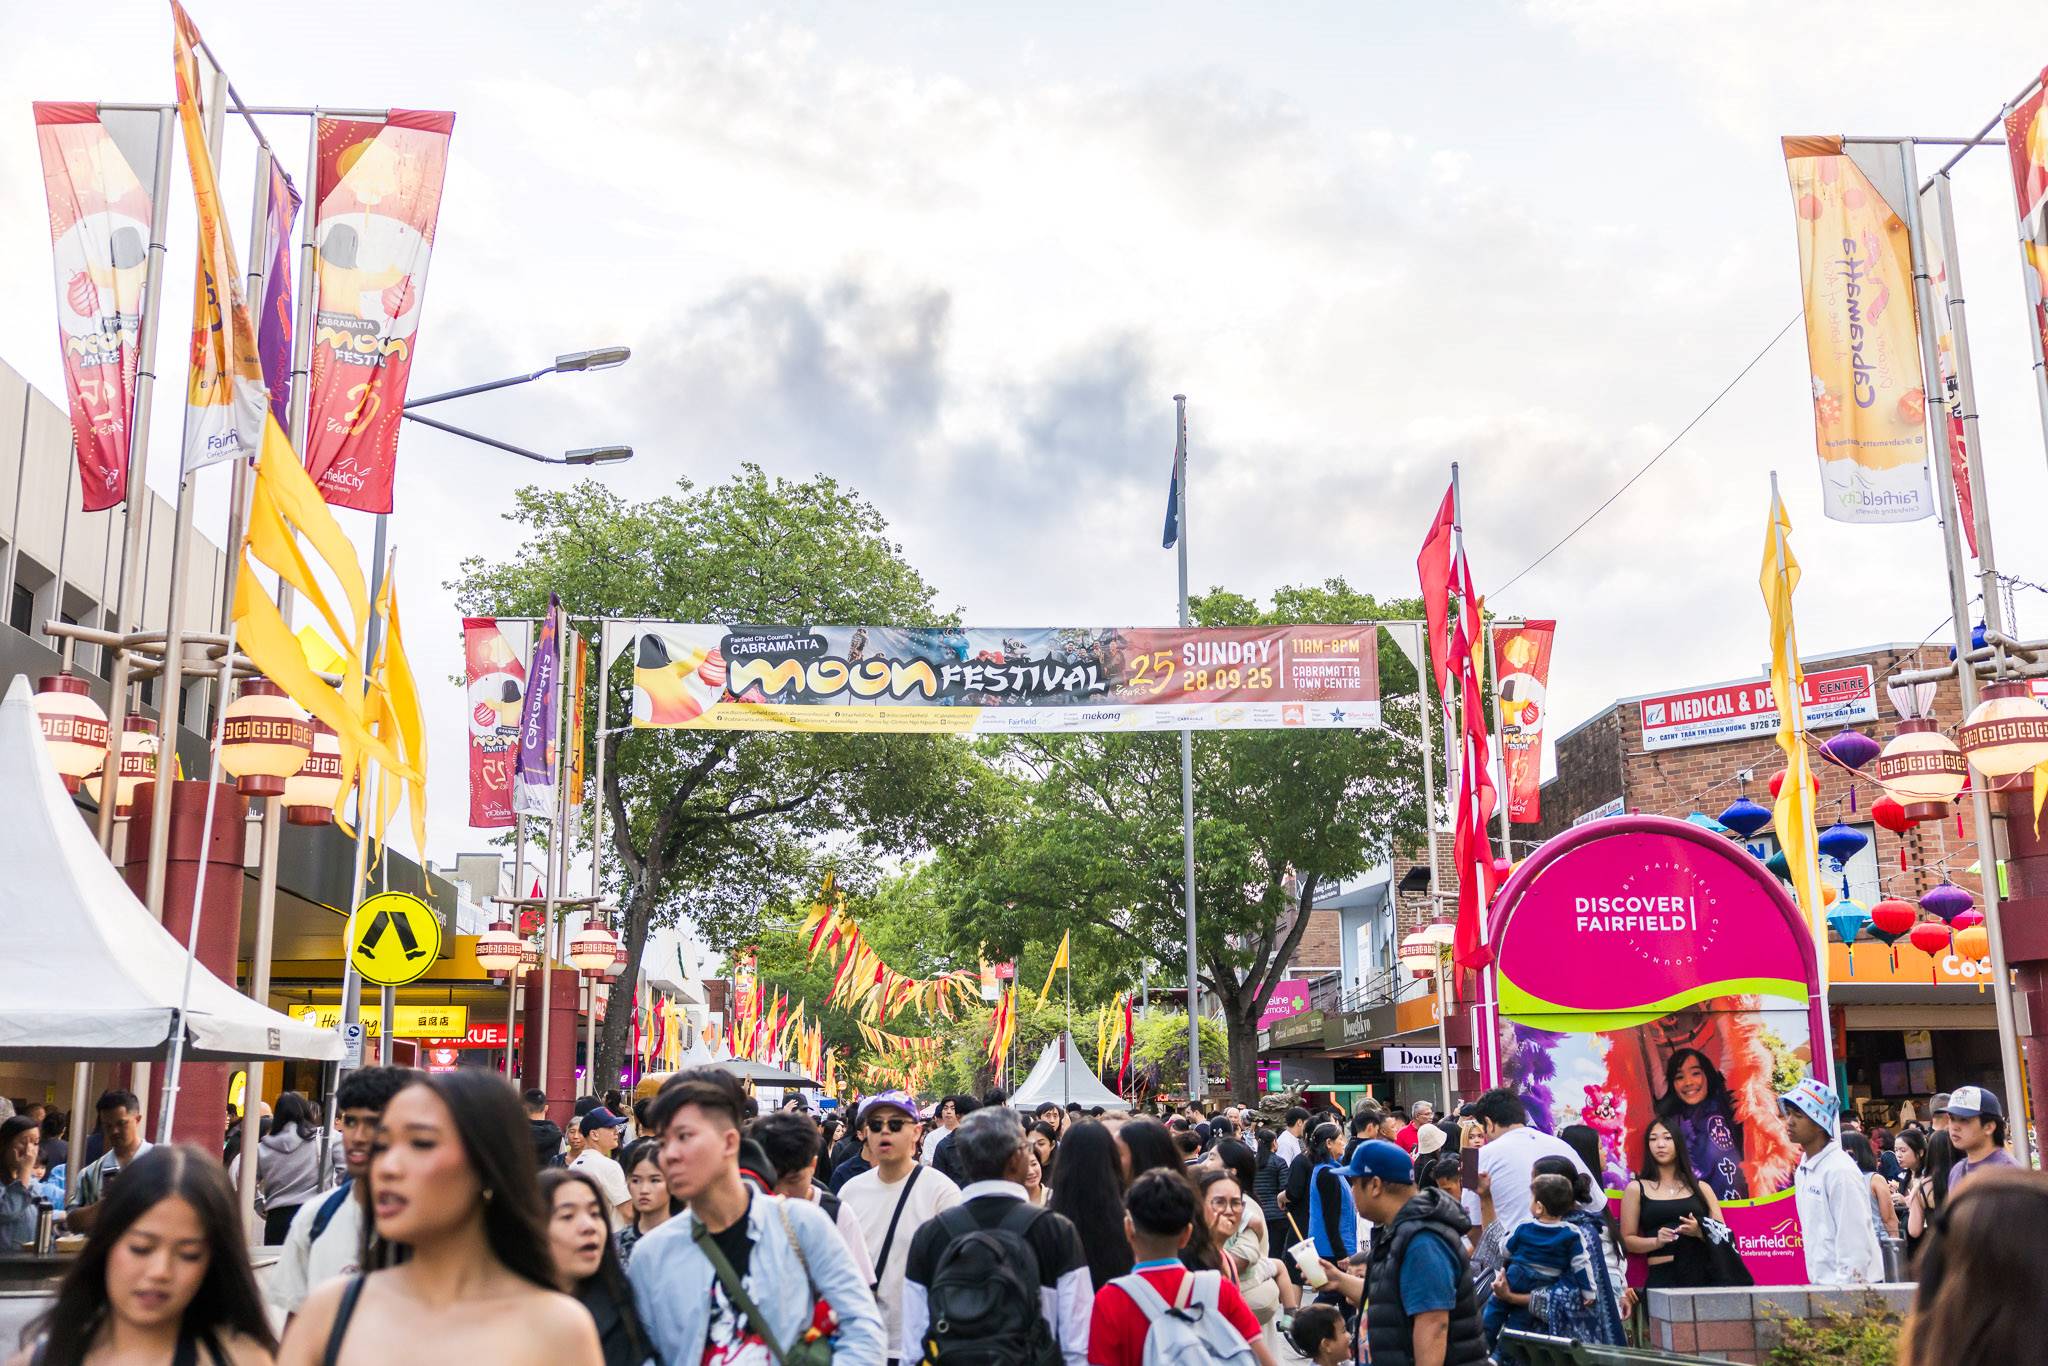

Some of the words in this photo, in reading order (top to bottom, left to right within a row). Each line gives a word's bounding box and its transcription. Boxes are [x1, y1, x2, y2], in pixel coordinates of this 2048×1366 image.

[730, 639, 819, 655] CABRAMATTA
[1183, 639, 1272, 667] SUNDAY
[1292, 638, 1360, 654] 11AM-8PM
[940, 664, 1106, 692] FESTIVAL
[1128, 650, 1176, 694] 25
[1183, 667, 1273, 692] 28.09.25
[1292, 665, 1361, 678] CABRAMATTA
[1293, 677, 1321, 689] TOWN
[1324, 677, 1361, 689] CENTRE
[525, 653, 552, 750] Cabramatta
[1670, 693, 1734, 722] MEDICAL
[1739, 691, 1751, 712] &
[1820, 678, 1864, 694] CENTRE
[1008, 717, 1037, 726] Fairfield
[1082, 711, 1121, 721] mekong
[1750, 721, 1769, 731] 9726
[1659, 733, 1678, 741] CATHY
[1622, 875, 1635, 890] BY
[1644, 862, 1717, 905] FAIRFIELD
[1575, 896, 1685, 913] DISCOVER
[1576, 915, 1687, 932] FAIRFIELD
[1702, 918, 1719, 952] CITY
[1629, 939, 1693, 966] COUNCIL
[1739, 1234, 1804, 1249] FairfieldCit
[1740, 1250, 1772, 1258] Celebrating
[1772, 1250, 1795, 1258] diversity
